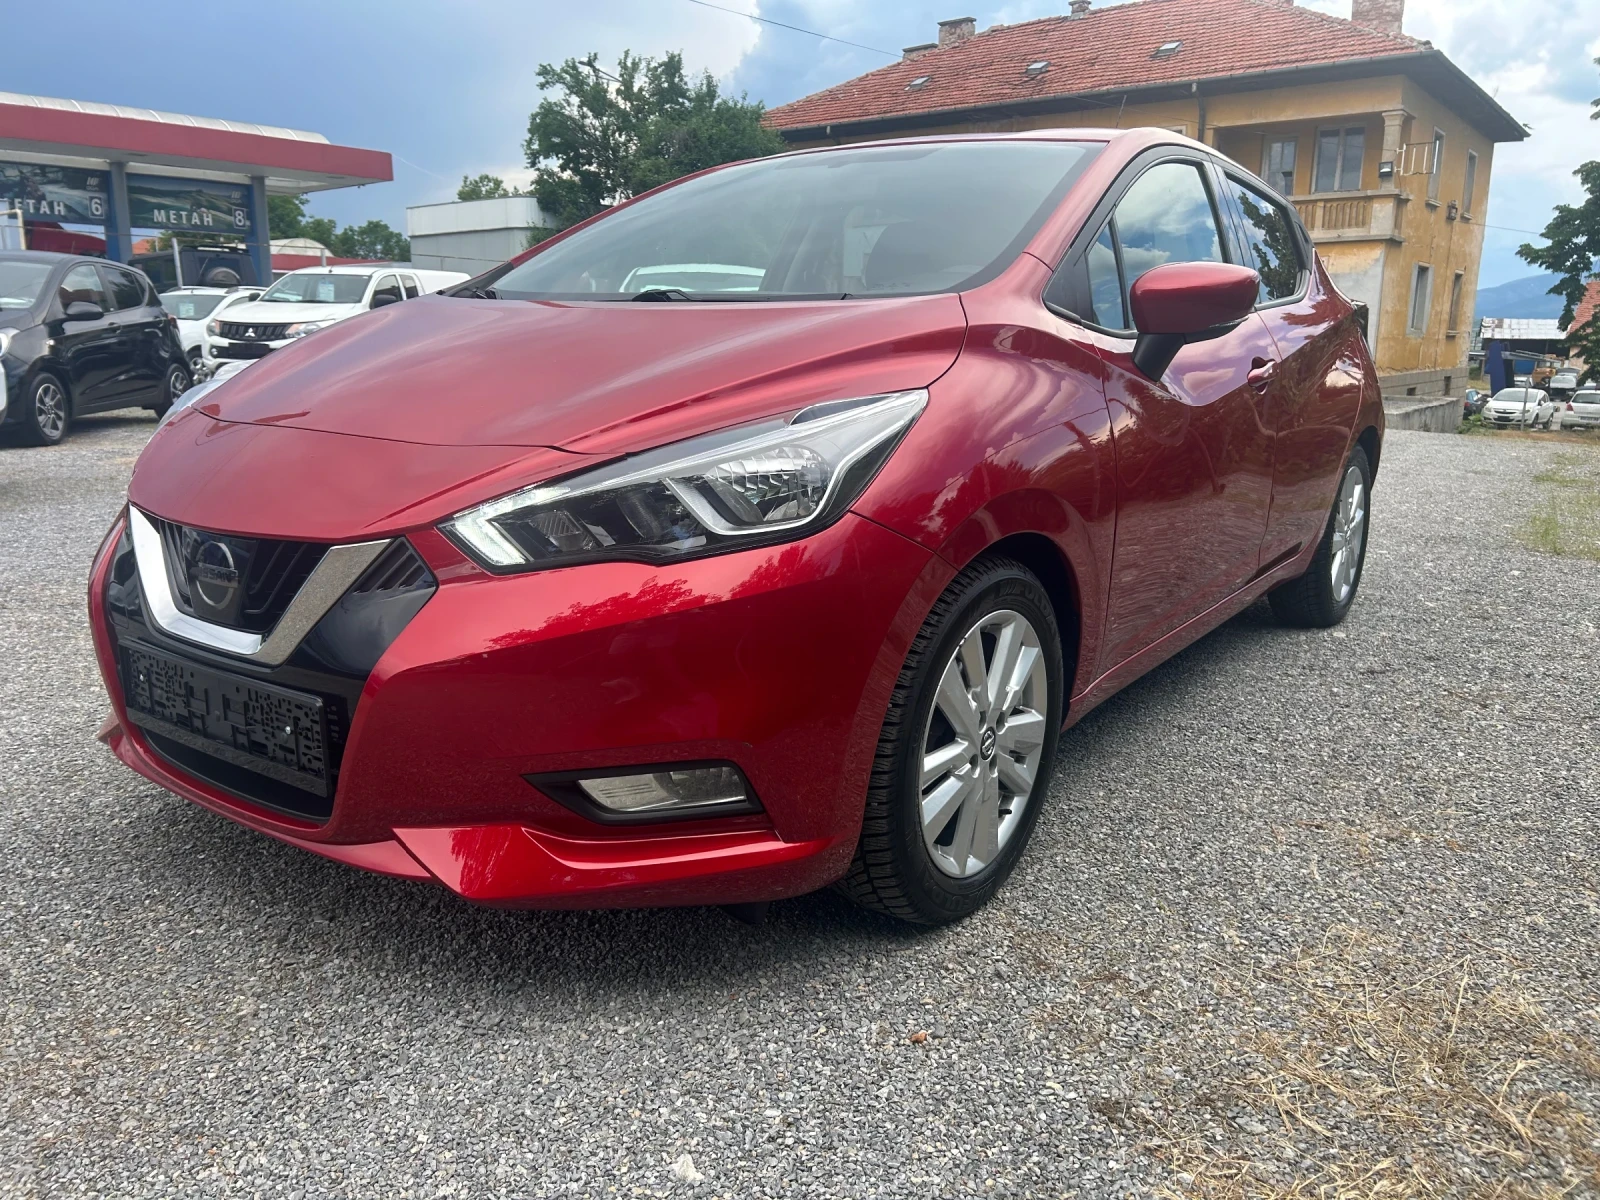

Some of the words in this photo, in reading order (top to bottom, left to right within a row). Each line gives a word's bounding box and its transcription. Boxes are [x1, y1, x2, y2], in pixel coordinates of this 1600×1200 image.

[91, 198, 102, 215] 6
[153, 208, 214, 226] МЕТАН
[235, 210, 245, 226] 8
